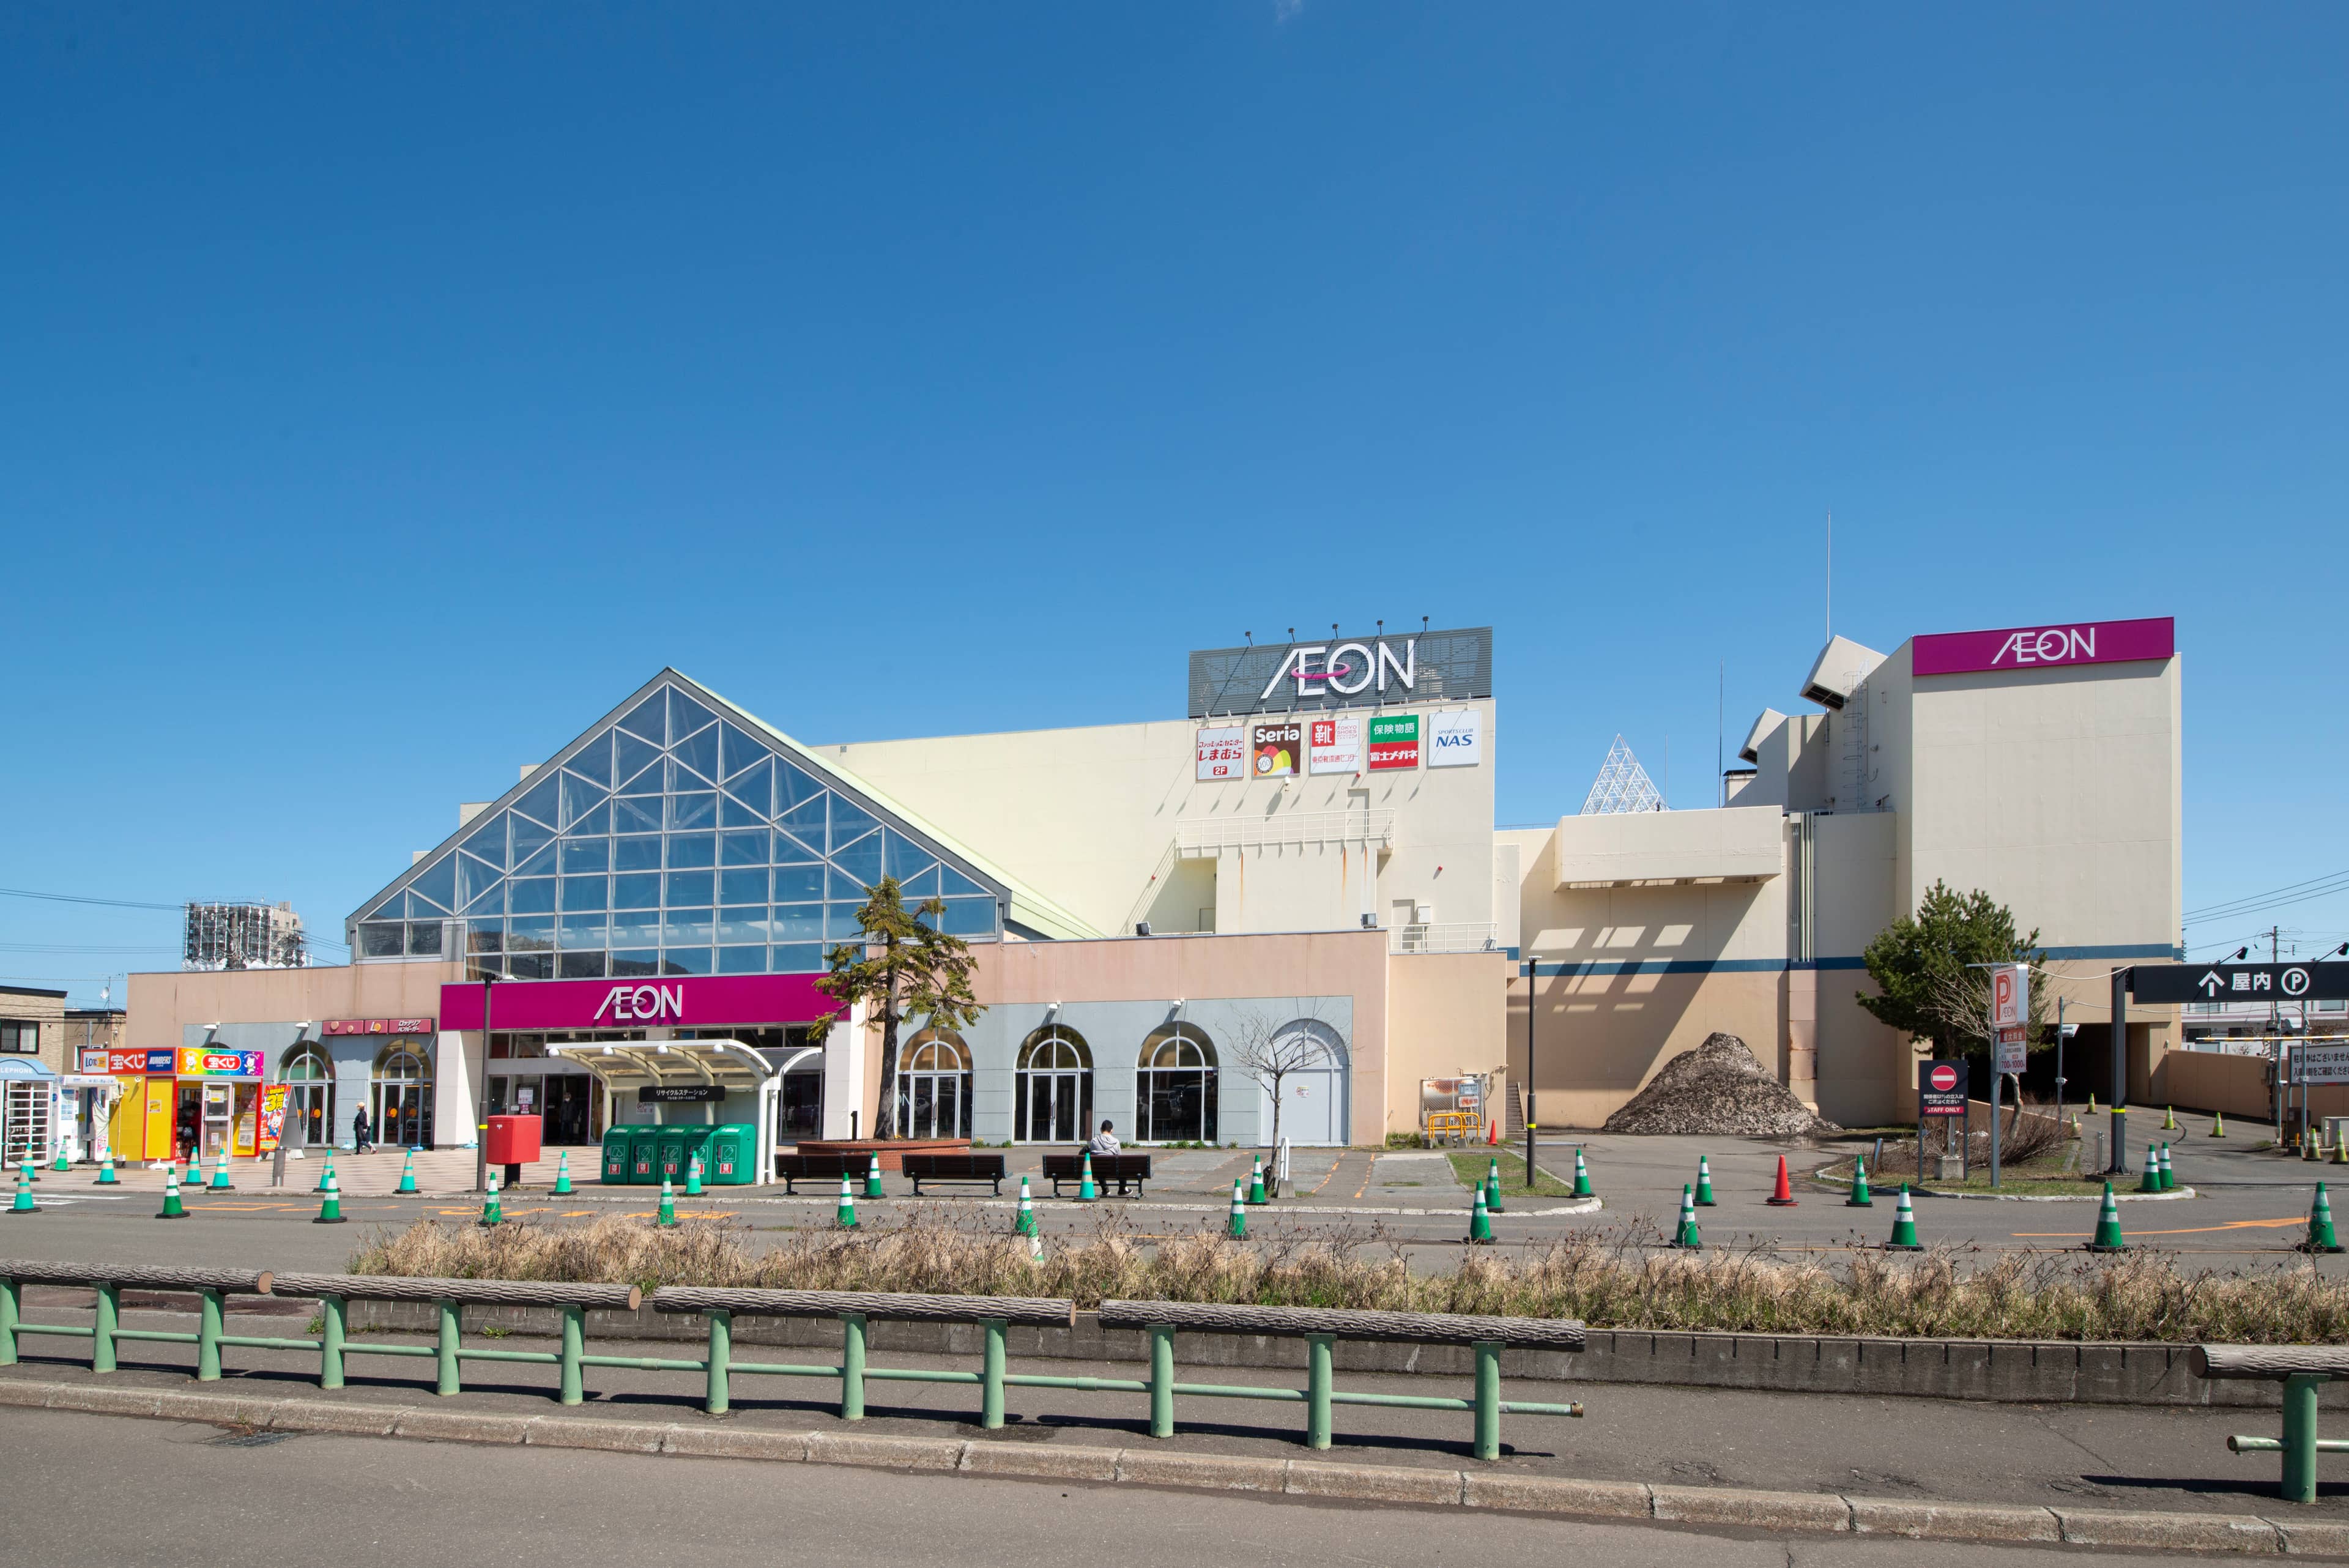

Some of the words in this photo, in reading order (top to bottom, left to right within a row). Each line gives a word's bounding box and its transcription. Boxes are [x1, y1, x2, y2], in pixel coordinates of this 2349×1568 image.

[1255, 725, 1299, 743] Seria
[1315, 724, 1332, 744] 靴
[1374, 723, 1415, 735] 保険物語
[1436, 734, 1472, 748] NAS
[1198, 748, 1242, 761] しまむら
[2232, 972, 2271, 991] 屋内
[111, 1053, 145, 1069] 宝くじ
[208, 1057, 235, 1068] 宝くじ
